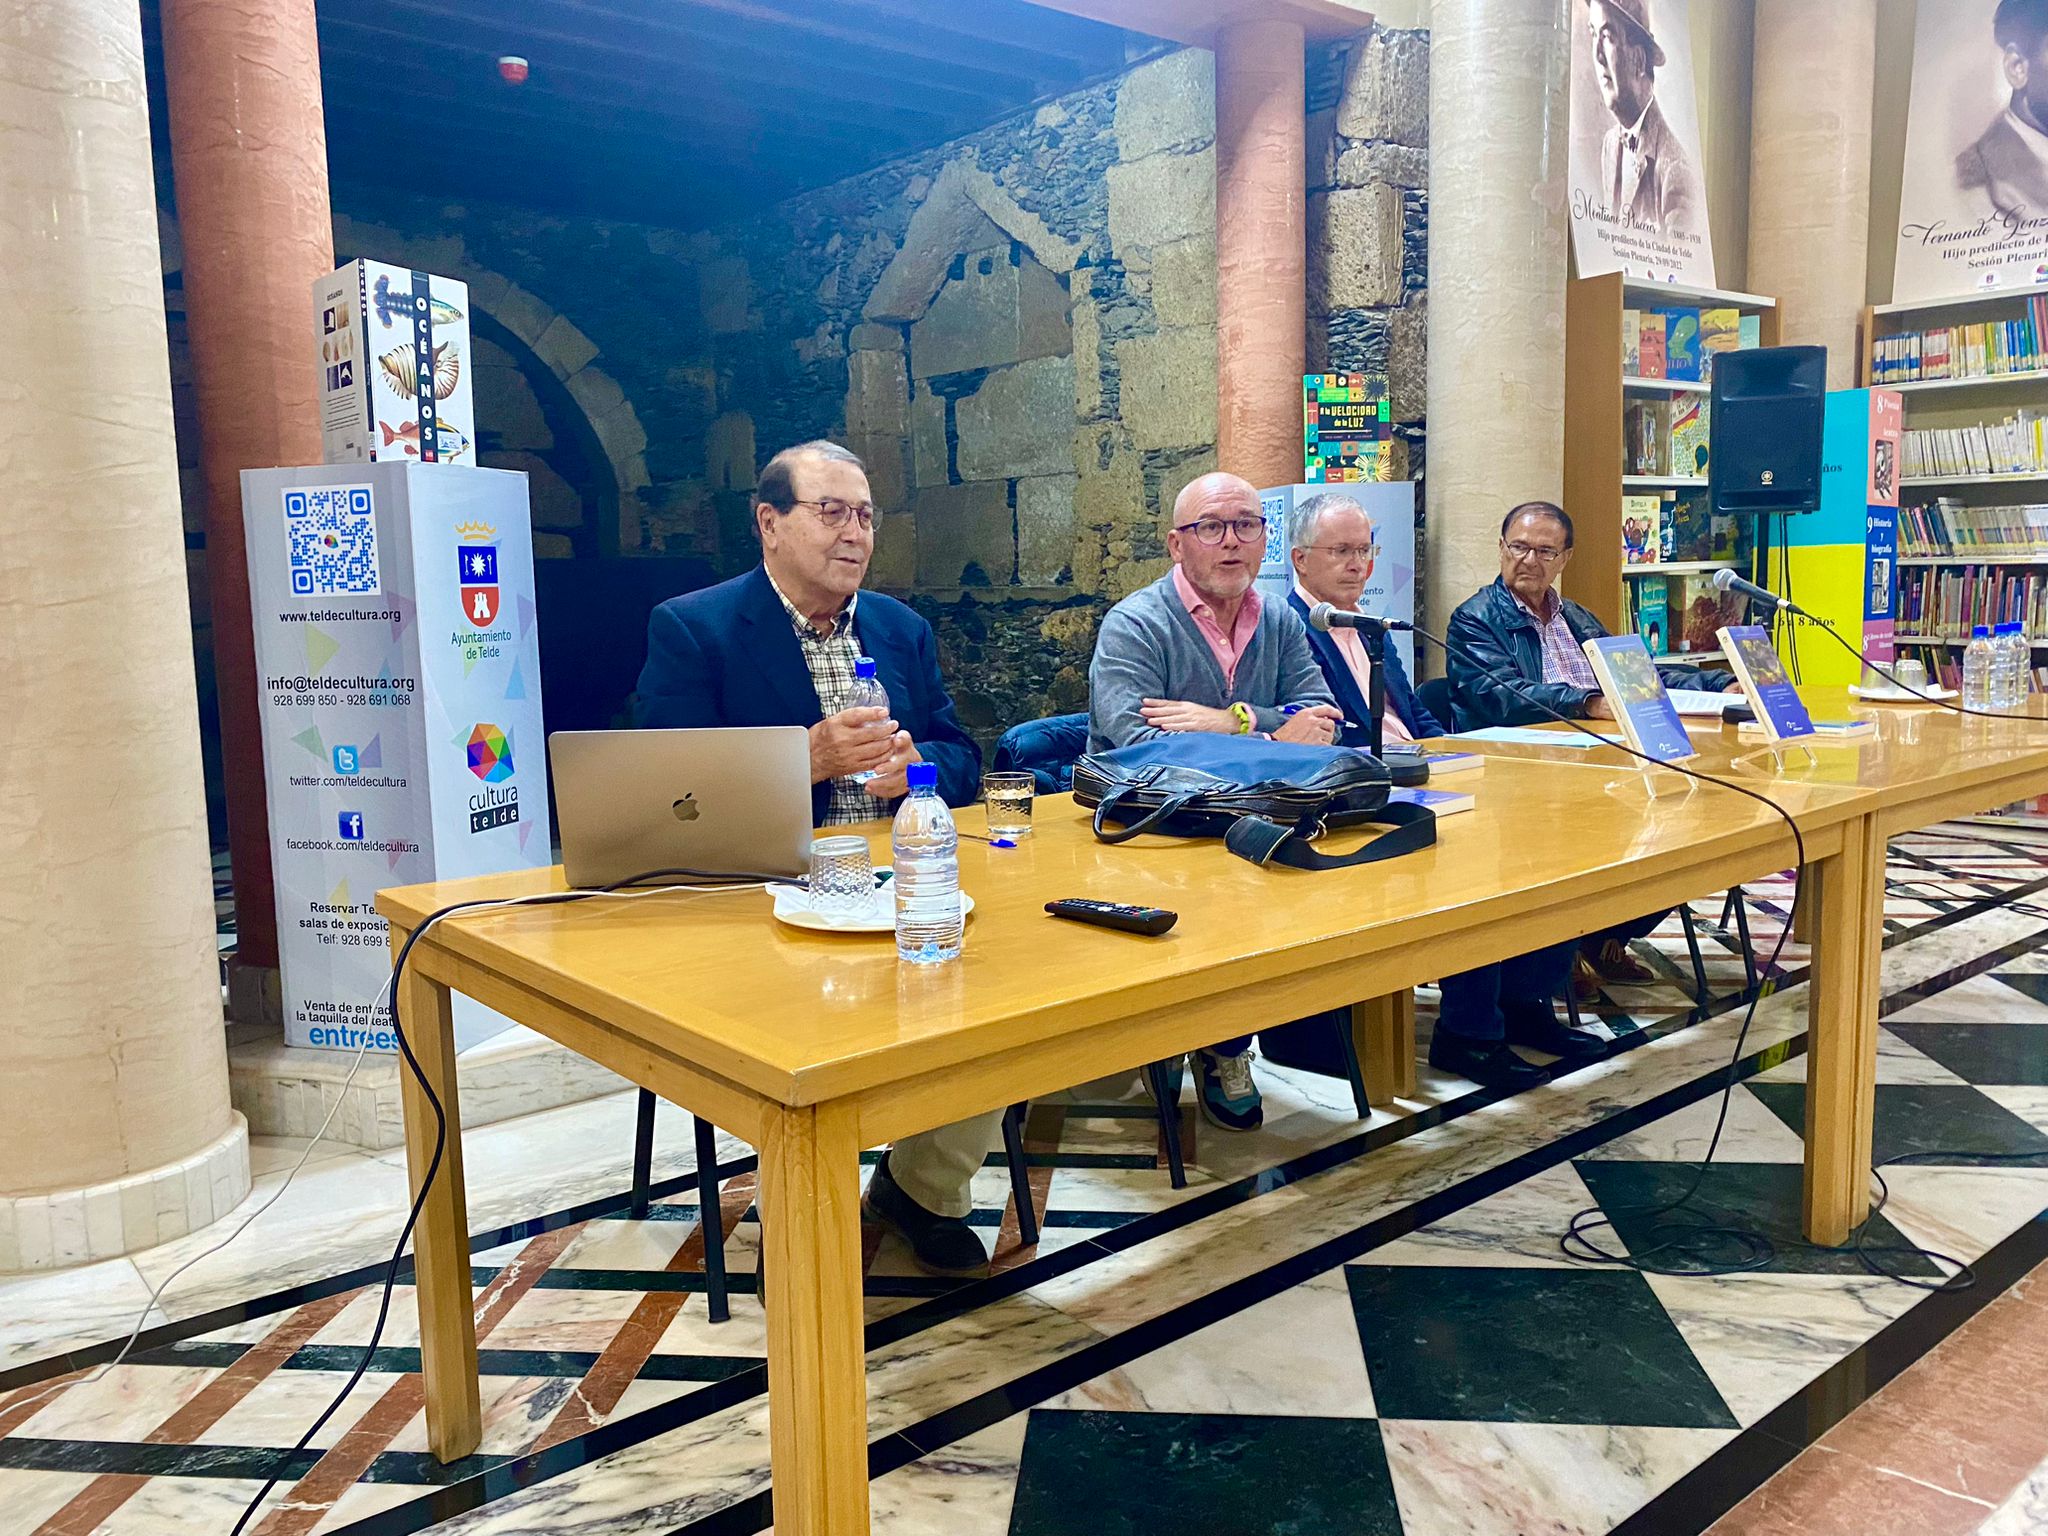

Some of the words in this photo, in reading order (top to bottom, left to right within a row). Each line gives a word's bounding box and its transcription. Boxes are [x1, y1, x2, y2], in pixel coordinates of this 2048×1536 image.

[1901, 219, 1994, 246] Fernando
[1597, 229, 1611, 242] Hijo
[1651, 241, 1672, 254] Ciudad
[1943, 249, 1966, 260] Hijo
[1969, 240, 2025, 258] predilecto
[2028, 235, 2042, 245] de
[1967, 257, 2003, 269] Sesión
[2006, 248, 2048, 263] Plenari
[415, 296, 433, 442] OCÉANOS
[1331, 405, 1377, 416] VELOCIDAD
[1348, 417, 1364, 428] LUZ
[1867, 516, 1873, 534] 9
[279, 608, 401, 623] www.teldecultura.org
[1798, 616, 1805, 626] 8
[451, 630, 512, 646] Ayuntamiento
[466, 648, 477, 660] de
[478, 646, 500, 659] Telde
[267, 675, 415, 692] info@teldecultura.org
[273, 695, 294, 706] 928
[296, 695, 316, 706] 699
[318, 695, 337, 706] 850
[347, 694, 367, 706] 928
[369, 694, 388, 706] 691
[391, 694, 411, 706] 068
[290, 775, 407, 788] twitter.com/teldecultura
[469, 784, 518, 811] cultura
[473, 808, 518, 830] telde
[287, 838, 419, 853] facebook.com/teldecultura
[310, 902, 359, 914] Reservar
[362, 904, 379, 915] Te
[300, 918, 328, 929] salas
[332, 919, 344, 929] de
[317, 934, 338, 945] Telf:
[341, 935, 360, 945] 928
[363, 936, 382, 946] 699
[304, 1000, 335, 1012] Venta
[339, 1002, 352, 1013] de
[297, 1011, 306, 1021] la
[309, 1011, 348, 1025] taquilla
[352, 1013, 368, 1024] del
